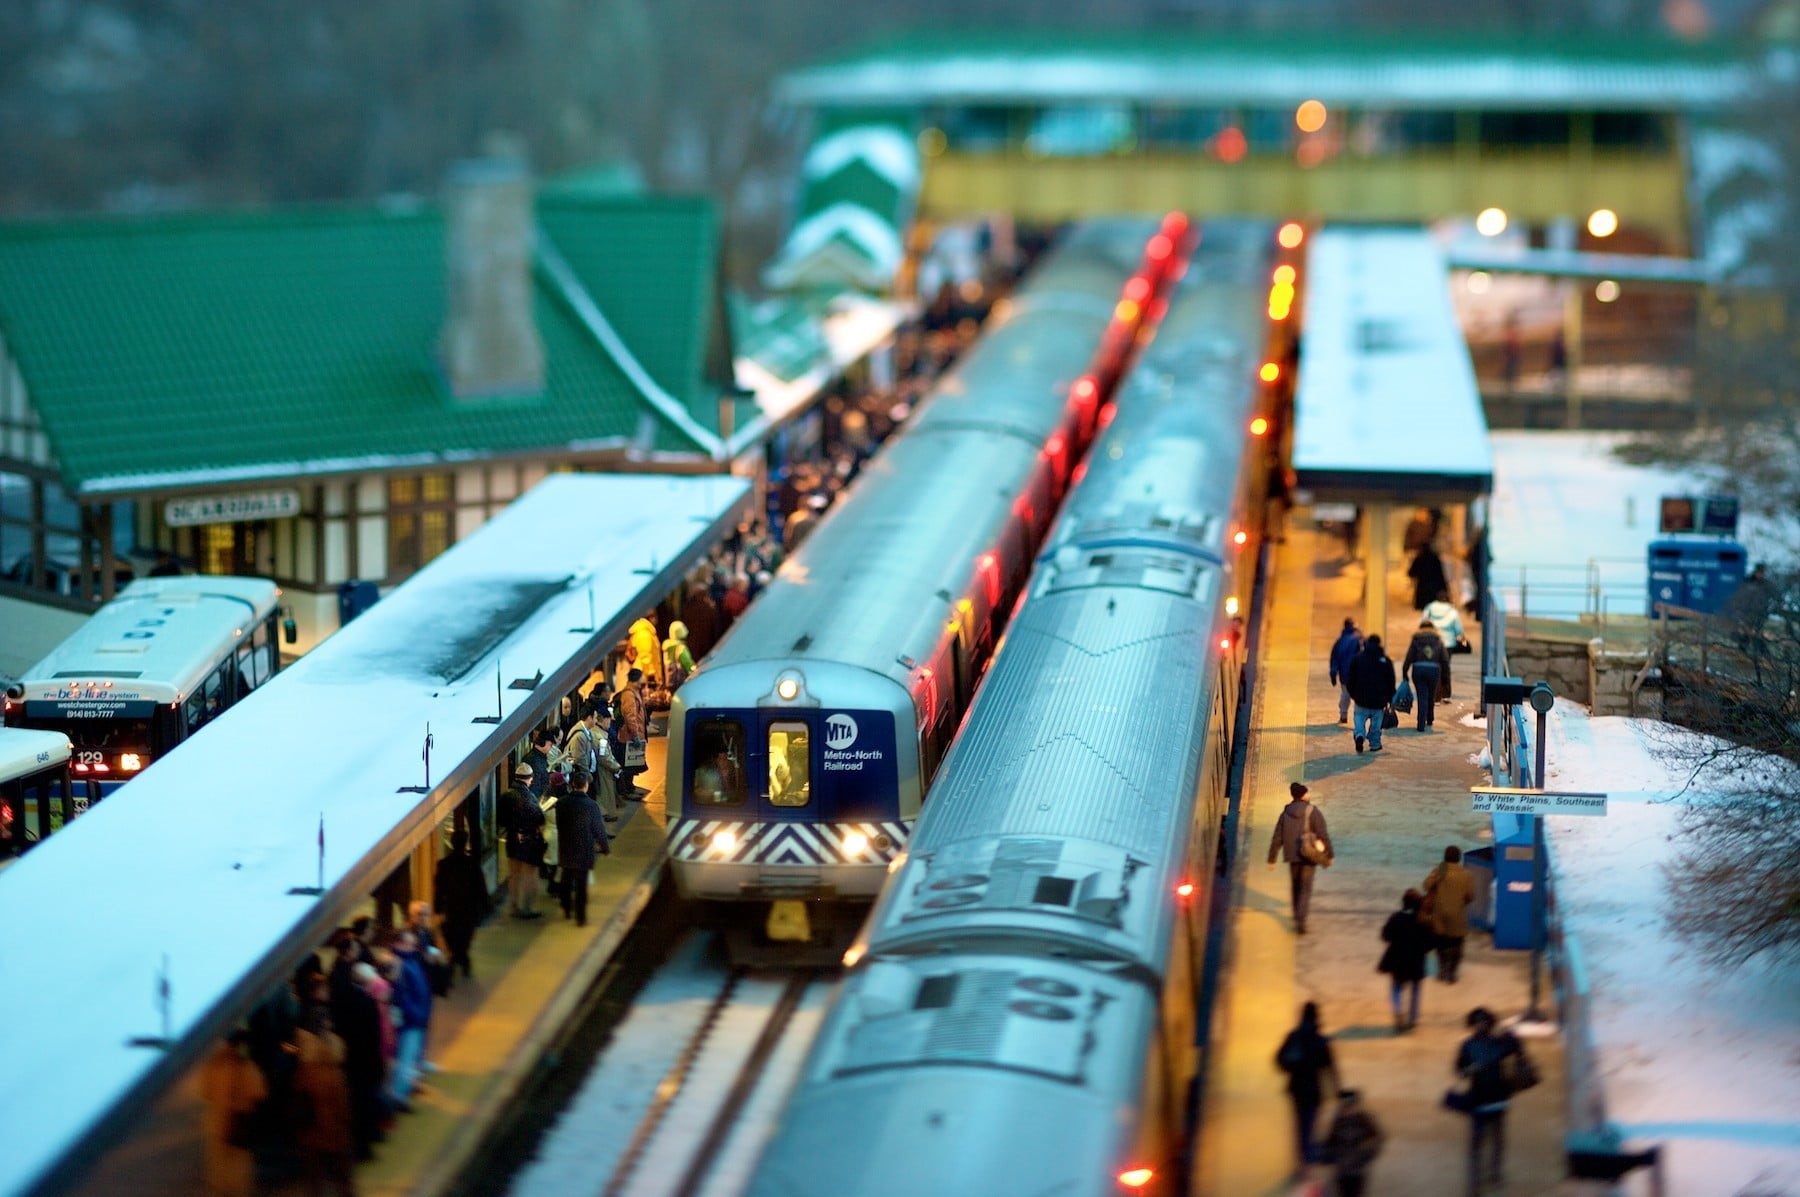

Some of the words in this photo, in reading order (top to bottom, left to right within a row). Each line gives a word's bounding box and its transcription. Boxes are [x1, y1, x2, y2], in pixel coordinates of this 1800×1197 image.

[110, 692, 140, 700] system
[57, 702, 126, 710] westchestergov.com
[67, 710, 83, 718] (914)
[84, 710, 114, 718] 813-7777
[825, 722, 852, 742] MTA
[77, 751, 103, 765] 129
[823, 750, 883, 760] Metro-North
[823, 761, 863, 771] Railroad
[1473, 794, 1484, 802] To
[1488, 795, 1515, 803] White
[1520, 796, 1551, 805] Plains,
[1555, 797, 1605, 807] Southeast
[1472, 803, 1491, 811] and
[1495, 804, 1535, 813] Wassaic
